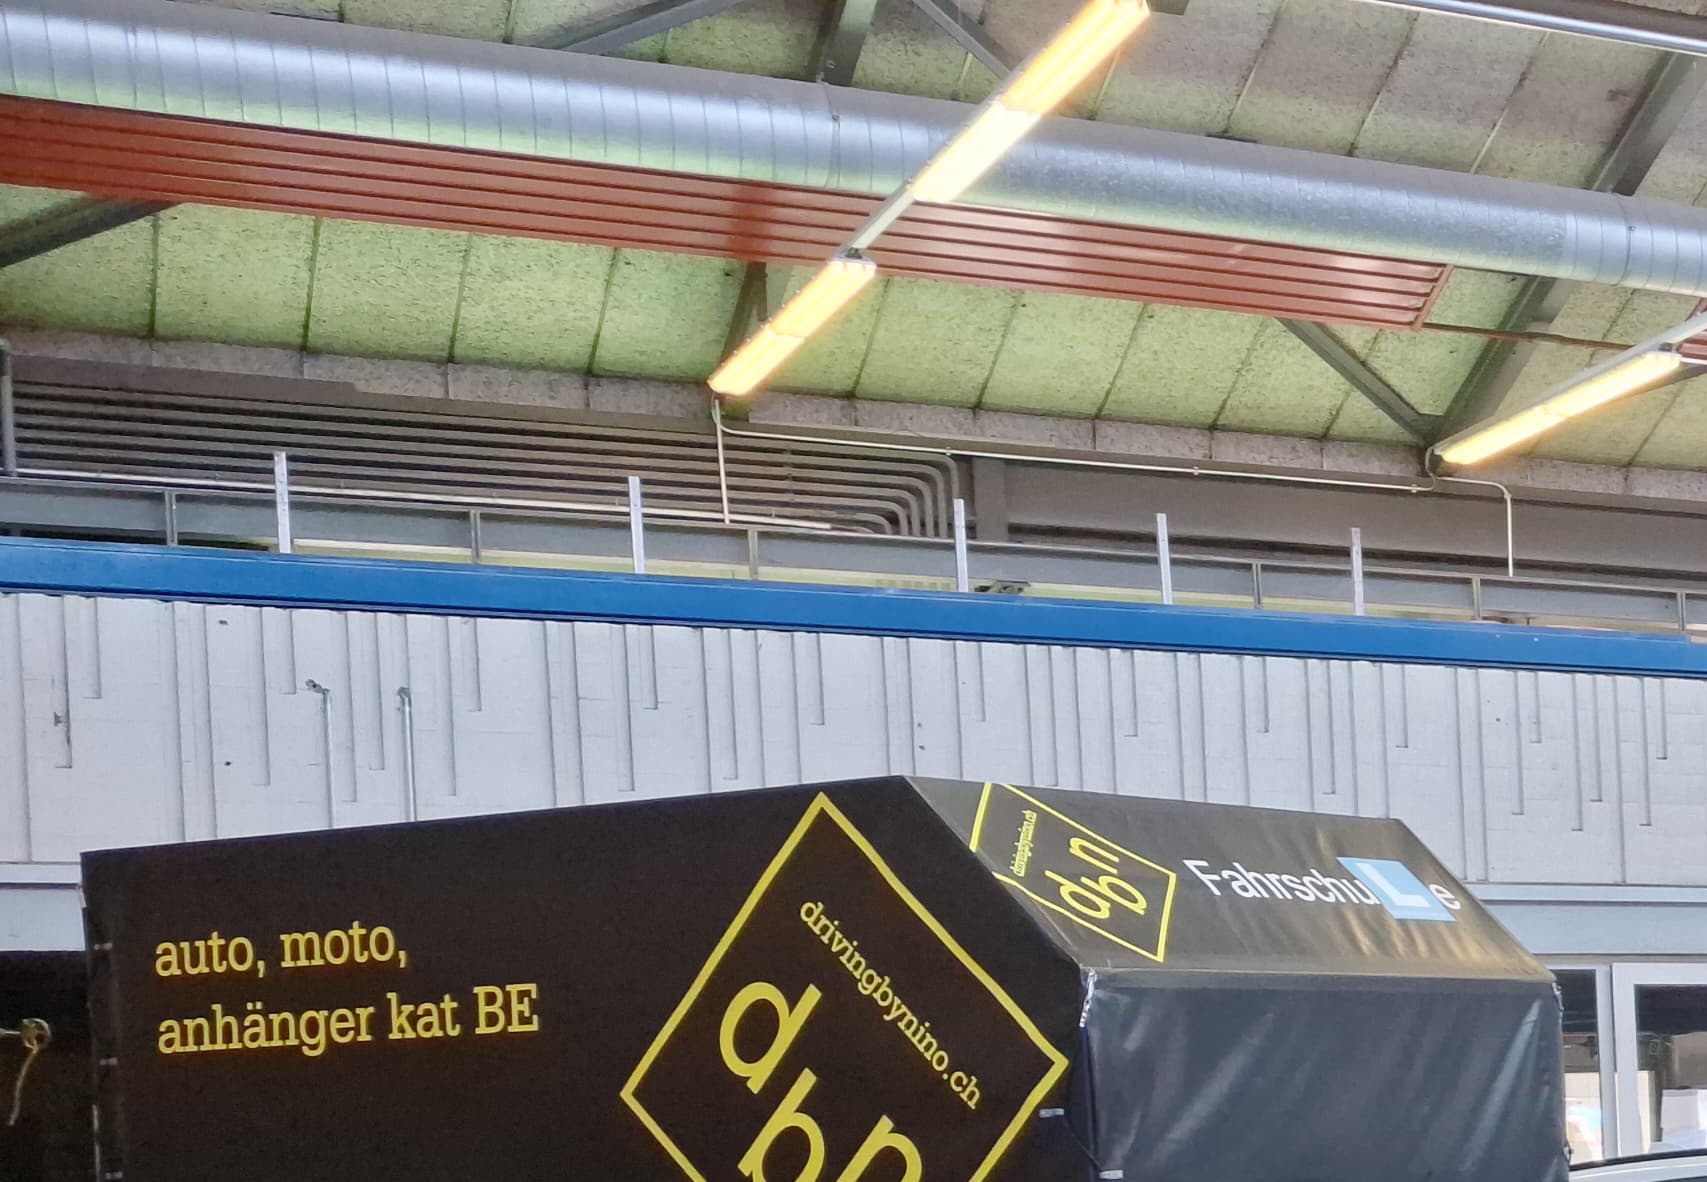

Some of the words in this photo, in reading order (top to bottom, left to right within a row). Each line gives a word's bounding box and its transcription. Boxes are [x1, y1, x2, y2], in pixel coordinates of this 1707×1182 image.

[1045, 837, 1147, 919] dbn
[154, 930, 266, 980] auto,
[279, 921, 408, 970] moto,
[157, 998, 375, 1056] anhänger
[386, 991, 462, 1041] kat
[473, 982, 540, 1036] BE
[799, 900, 982, 1110] drivingbynino.ch
